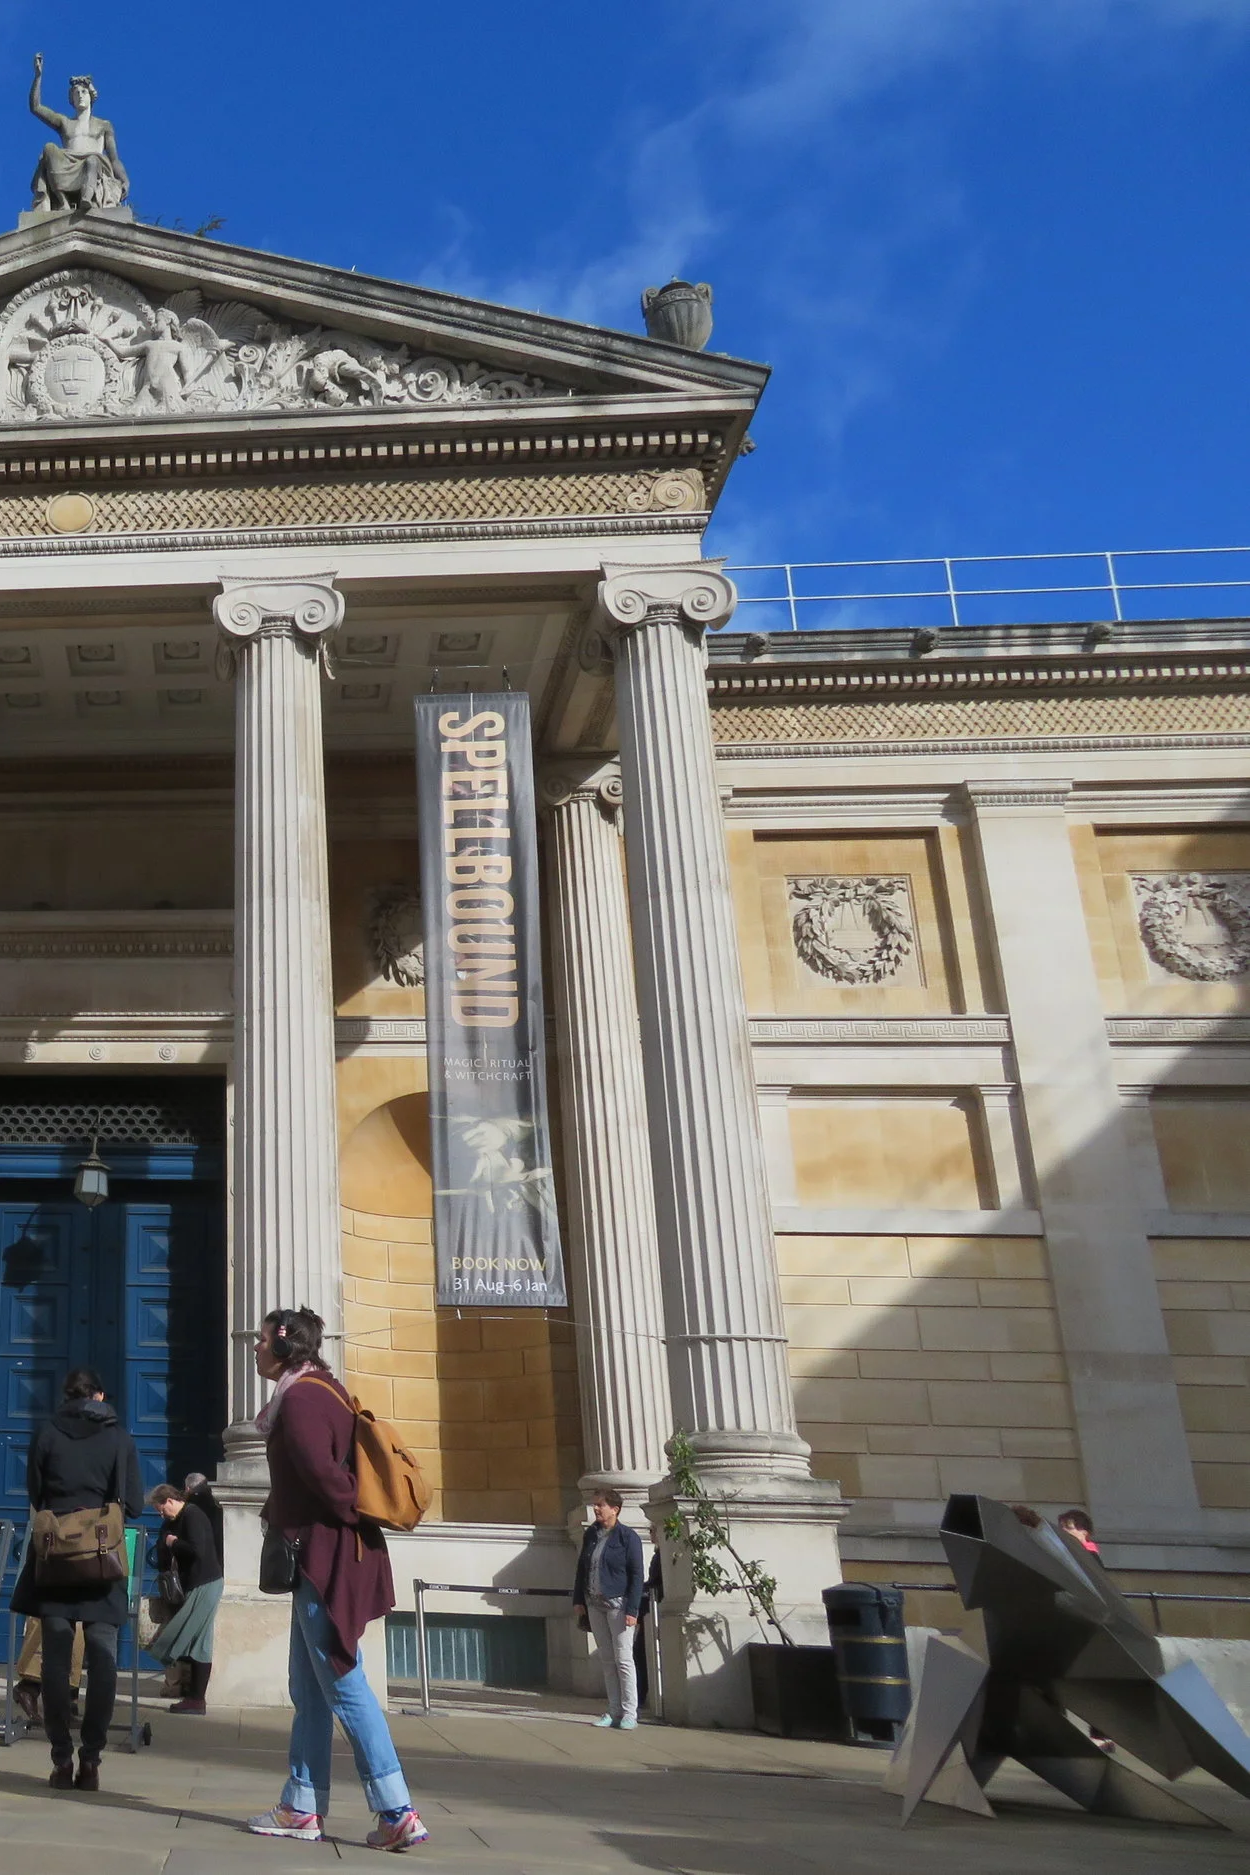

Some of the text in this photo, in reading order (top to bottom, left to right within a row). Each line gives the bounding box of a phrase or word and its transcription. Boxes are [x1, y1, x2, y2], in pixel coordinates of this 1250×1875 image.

[438, 711, 519, 1028] SPELLBOUND
[444, 1057, 531, 1068] MAGIC RITUAL
[444, 1069, 531, 1080] & WITCHCRAFT
[452, 1256, 546, 1271] BOOK NOW
[453, 1277, 470, 1291] 31
[525, 1278, 548, 1292] Jan
